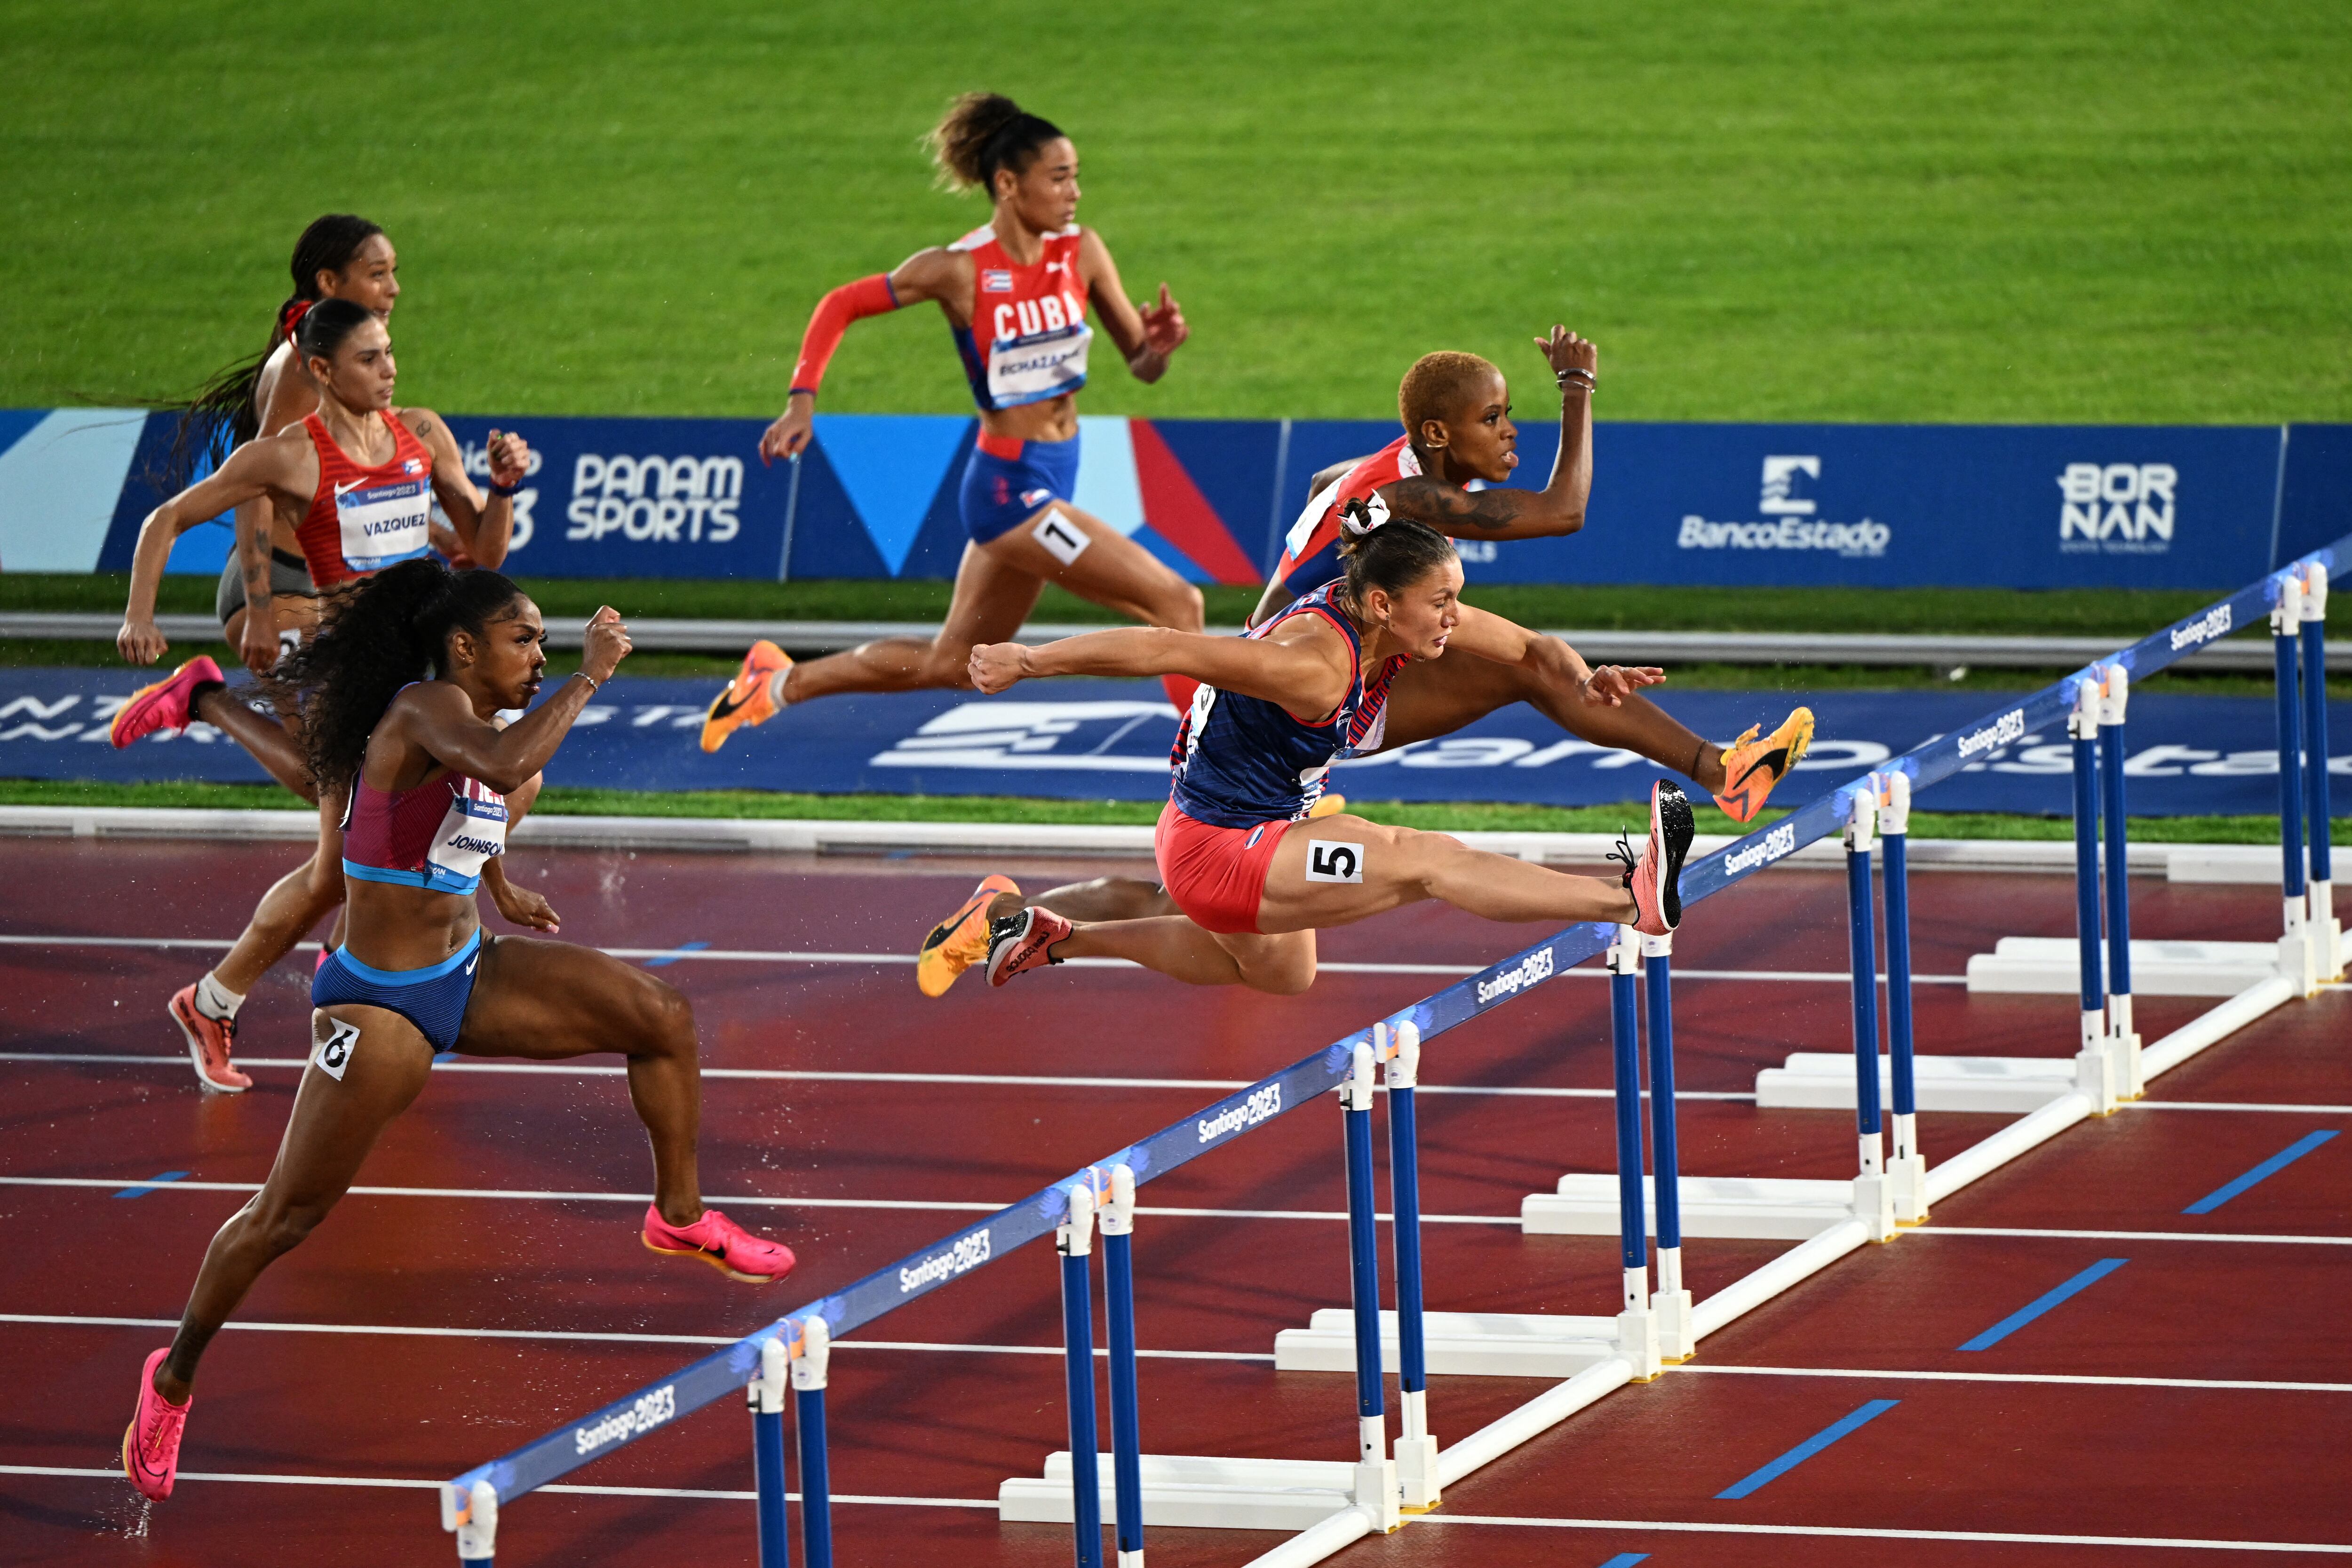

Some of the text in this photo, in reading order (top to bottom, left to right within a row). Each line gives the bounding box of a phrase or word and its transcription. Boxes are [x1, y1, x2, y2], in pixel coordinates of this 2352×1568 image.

[573, 454, 744, 498] PANAM
[2058, 462, 2178, 503] BOR
[364, 513, 425, 536] VAZQUEZ
[566, 497, 741, 542] SPORTS
[1045, 523, 1077, 549] 1
[1677, 515, 1891, 549] BancoEstado
[2060, 503, 2175, 541] NAN
[2171, 604, 2231, 650] Santiago 2023
[1958, 708, 2024, 758] Santiago 2023
[474, 803, 502, 818] Santiago 2023
[1313, 846, 1356, 879] 5
[1725, 823, 1795, 876] Santiago 2023
[1006, 945, 1038, 972] balance
[1478, 947, 1553, 1003] Santiago 2023
[324, 1029, 354, 1068] 6
[1199, 1083, 1281, 1143] Santiago 2023
[900, 1228, 991, 1292] Santiago 2023
[576, 1385, 675, 1455] Santiago 2023
